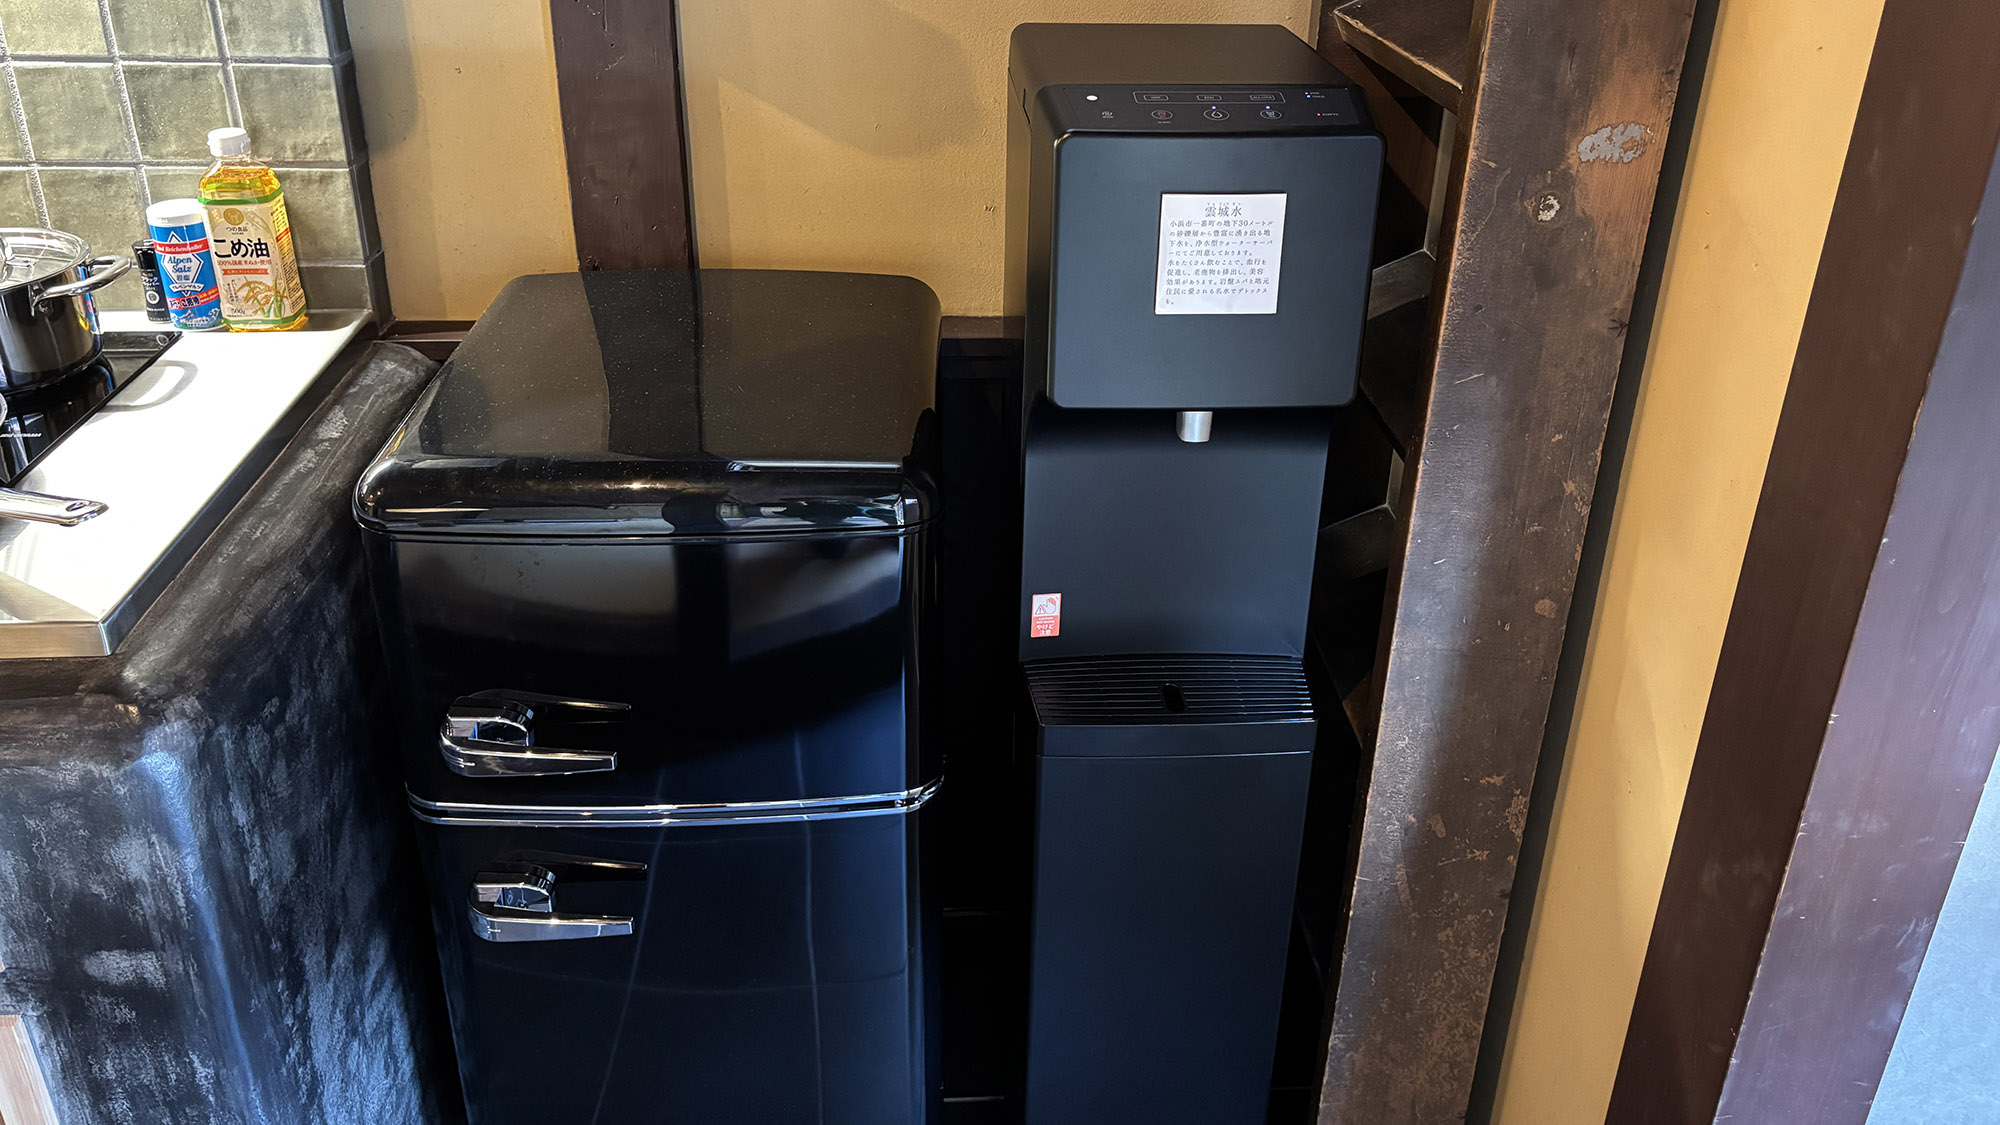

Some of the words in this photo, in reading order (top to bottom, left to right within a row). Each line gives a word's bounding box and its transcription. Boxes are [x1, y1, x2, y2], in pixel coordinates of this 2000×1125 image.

[1204, 205, 1243, 218] 雲城水
[1169, 218, 1274, 228] 小浜市一番町の地下30メートル
[213, 238, 271, 259] こめ油
[168, 256, 193, 266] Alpen
[172, 264, 192, 273] Salz
